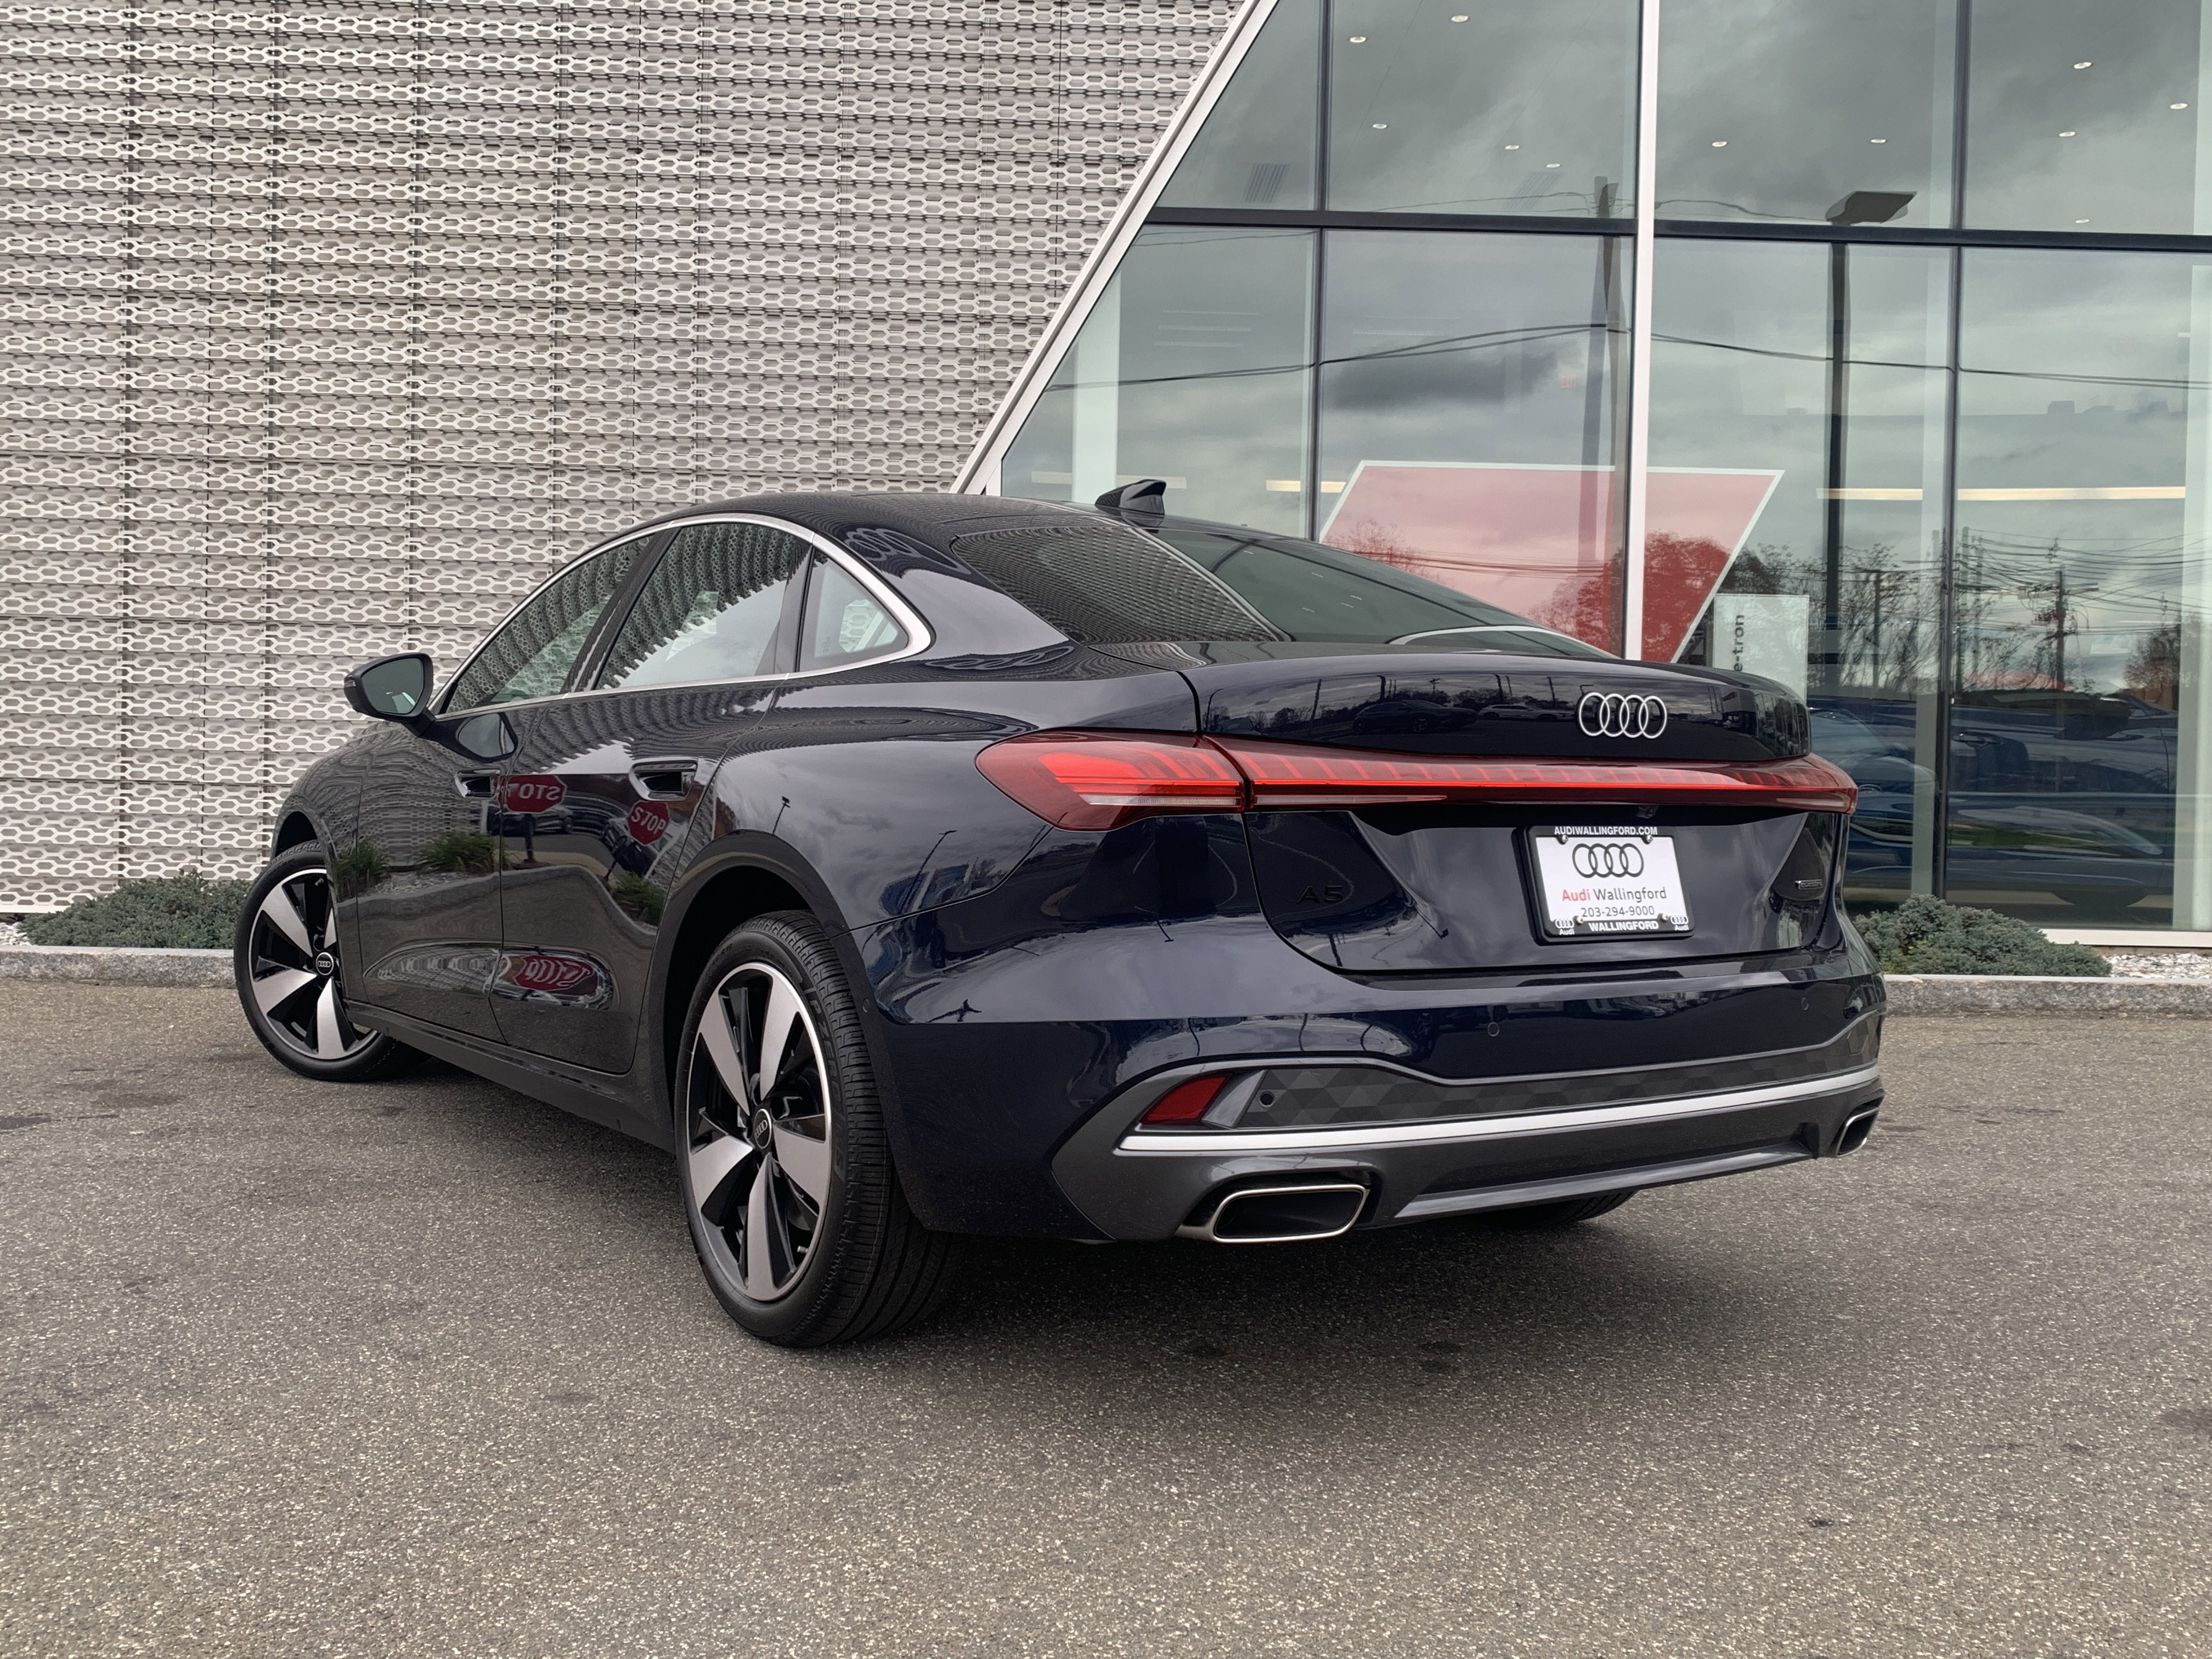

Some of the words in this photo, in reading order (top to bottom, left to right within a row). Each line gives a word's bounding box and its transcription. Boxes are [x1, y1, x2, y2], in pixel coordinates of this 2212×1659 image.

[1733, 615, 1745, 672] e-tron
[631, 806, 667, 834] STOP
[1554, 826, 1657, 835] AUDIWALLINGFORD.COM
[1296, 885, 1343, 904] A5
[1562, 888, 1591, 901] Audi
[1593, 887, 1667, 903] Wallingford
[1581, 906, 1655, 917] 203-294-9000
[1588, 921, 1659, 932] WALLINGFORD
